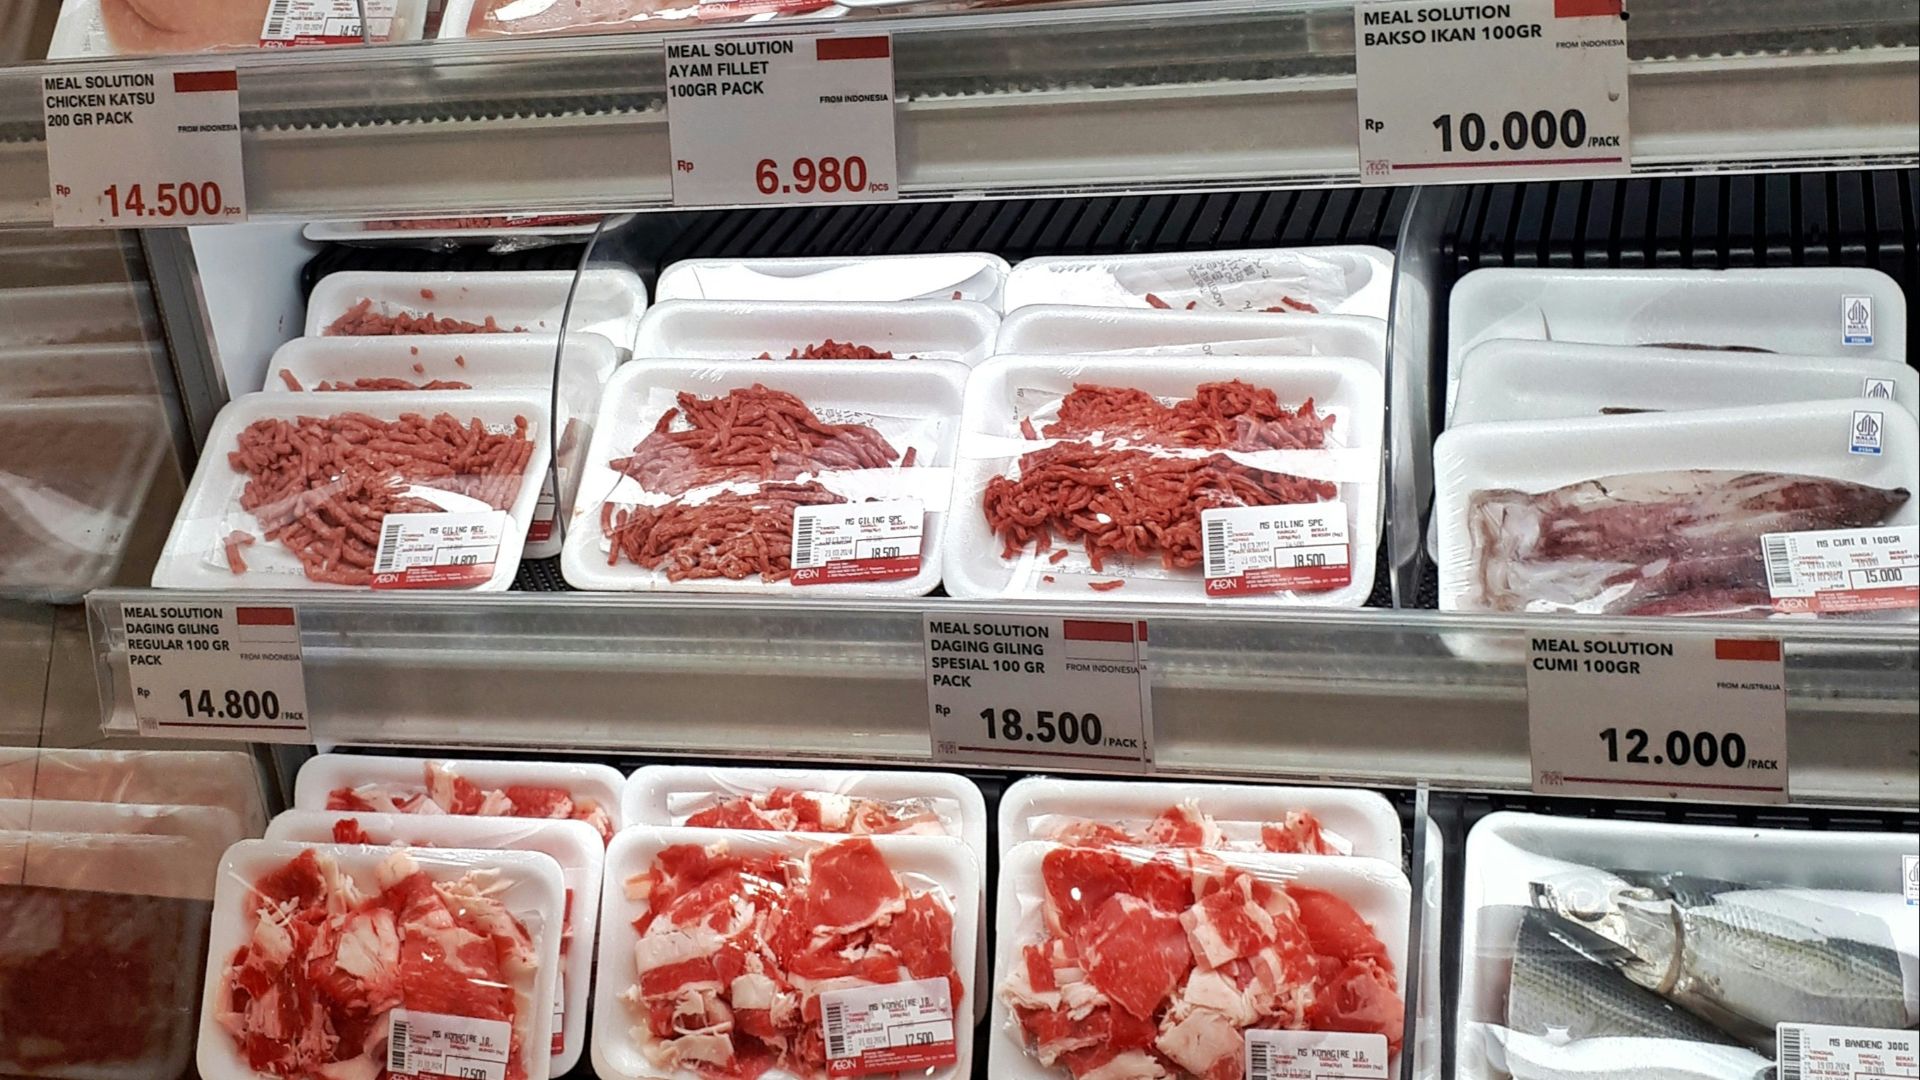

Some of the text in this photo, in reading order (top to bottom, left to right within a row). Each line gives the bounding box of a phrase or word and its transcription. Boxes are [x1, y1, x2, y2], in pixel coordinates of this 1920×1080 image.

[1364, 4, 1511, 26] MEAL SOLUTION
[1364, 24, 1542, 46] BAKSO IKAN 100GR
[668, 40, 794, 58] MEAL SOLUTION
[1556, 38, 1624, 49] FROM INDONESIA
[669, 61, 770, 78] AYAM FILLET
[45, 74, 154, 90] MEAL SOLUTION
[670, 81, 764, 97] 100GR PACK
[46, 92, 155, 108] CHICKEN KATSU
[820, 94, 888, 104] FROM INDONESIA
[48, 112, 134, 127] 200 GR PACK
[200, 124, 238, 132] INDONESIA
[1365, 108, 1620, 152] Rp 10.000 /PACK
[677, 156, 889, 195] Rp 6.980 /pcs
[56, 181, 241, 217] Rp 14.500 /pcs
[858, 516, 885, 524] GILING
[1260, 518, 1324, 530] MS GILING SPC
[442, 526, 468, 534] GILING
[1816, 540, 1828, 548] MS
[1834, 538, 1856, 546] CUMI
[1872, 535, 1900, 544] 100GR
[1864, 568, 1902, 584] 15.000
[124, 608, 223, 619] MEAL SOLUTION
[126, 624, 220, 635] DAGING GILING
[930, 622, 1050, 638] MEAL SOLUTION
[128, 640, 230, 651] REGULAR 100 GR
[931, 640, 1044, 656] DAGING GILING
[1532, 638, 1674, 656] MEAL SOLUTION
[130, 654, 162, 666] PACK
[932, 657, 1046, 674] SPESIAL 100 GR
[1533, 658, 1640, 674] CUMI 100GR
[1066, 663, 1140, 674] FROM INDONESIA
[933, 674, 972, 688] PACK
[1716, 682, 1780, 691] FROM AUSTRALIA
[137, 687, 150, 698] Rp
[178, 689, 280, 720] 14.800
[935, 704, 951, 717] Rp
[980, 708, 1102, 746] 18.500
[1598, 727, 1778, 770] 12.000 /PACK
[1829, 1038, 1910, 1051] MS BANDENG 300G
[1298, 1048, 1308, 1057] MS
[1312, 1048, 1350, 1060] KOMAGIRE
